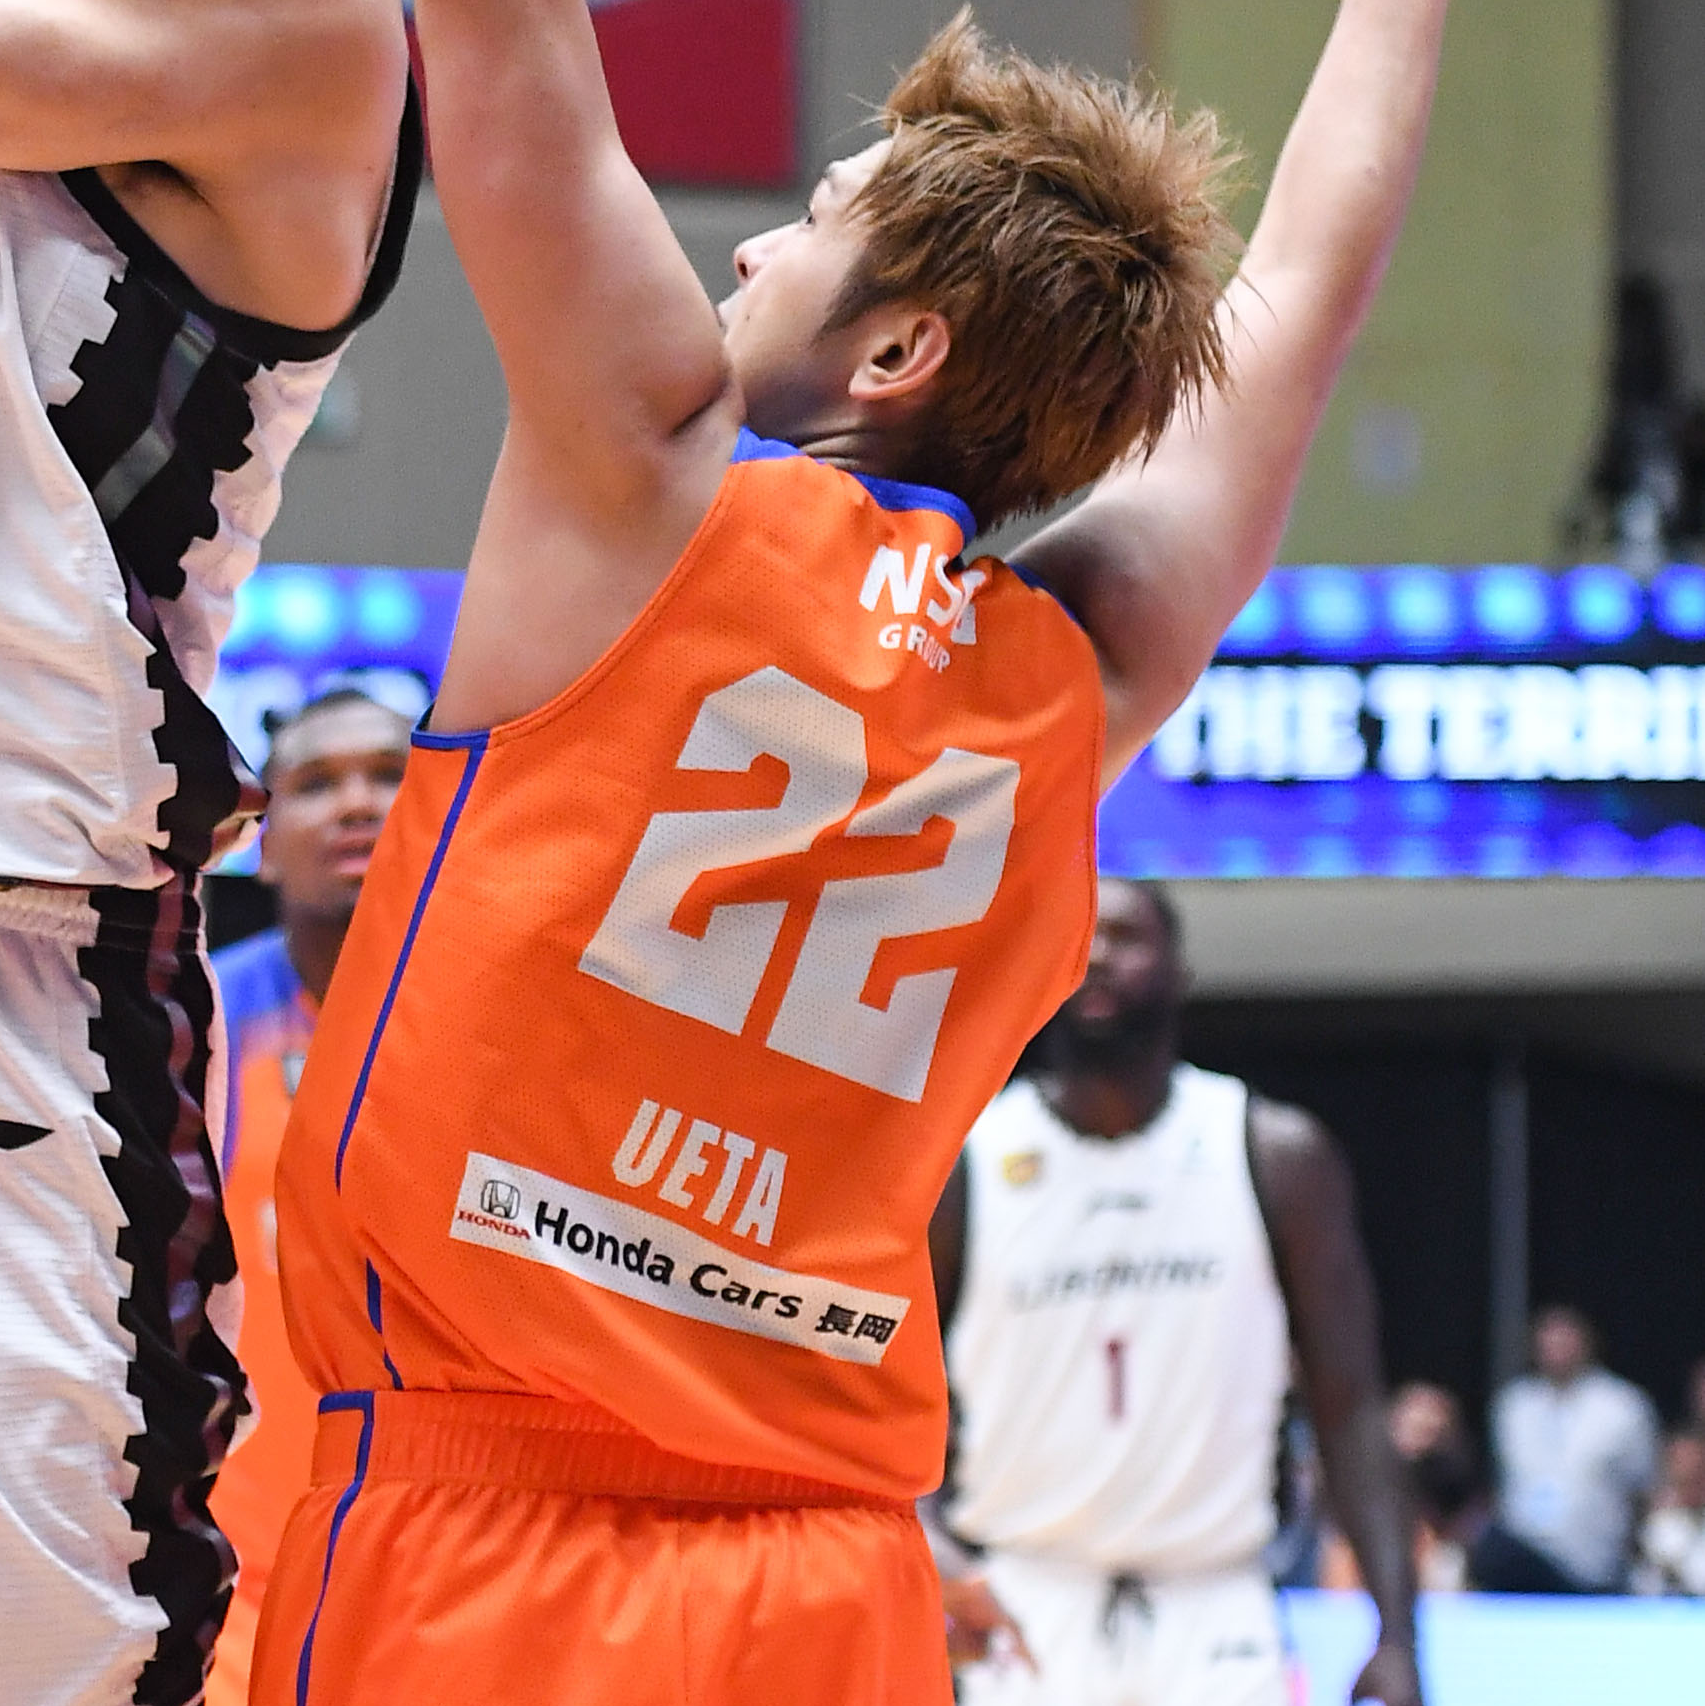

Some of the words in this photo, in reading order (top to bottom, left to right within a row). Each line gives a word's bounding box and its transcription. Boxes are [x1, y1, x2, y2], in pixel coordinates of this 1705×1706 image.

[1366, 664, 1705, 781] TERRI
[578, 665, 1022, 1103] 22
[457, 1209, 532, 1241] HONDA
[611, 1099, 788, 1247] UETA
[533, 1200, 675, 1287] Honda
[690, 1262, 803, 1321] Cars
[814, 1303, 898, 1345] 長岡
[1104, 1337, 1126, 1423] 1
